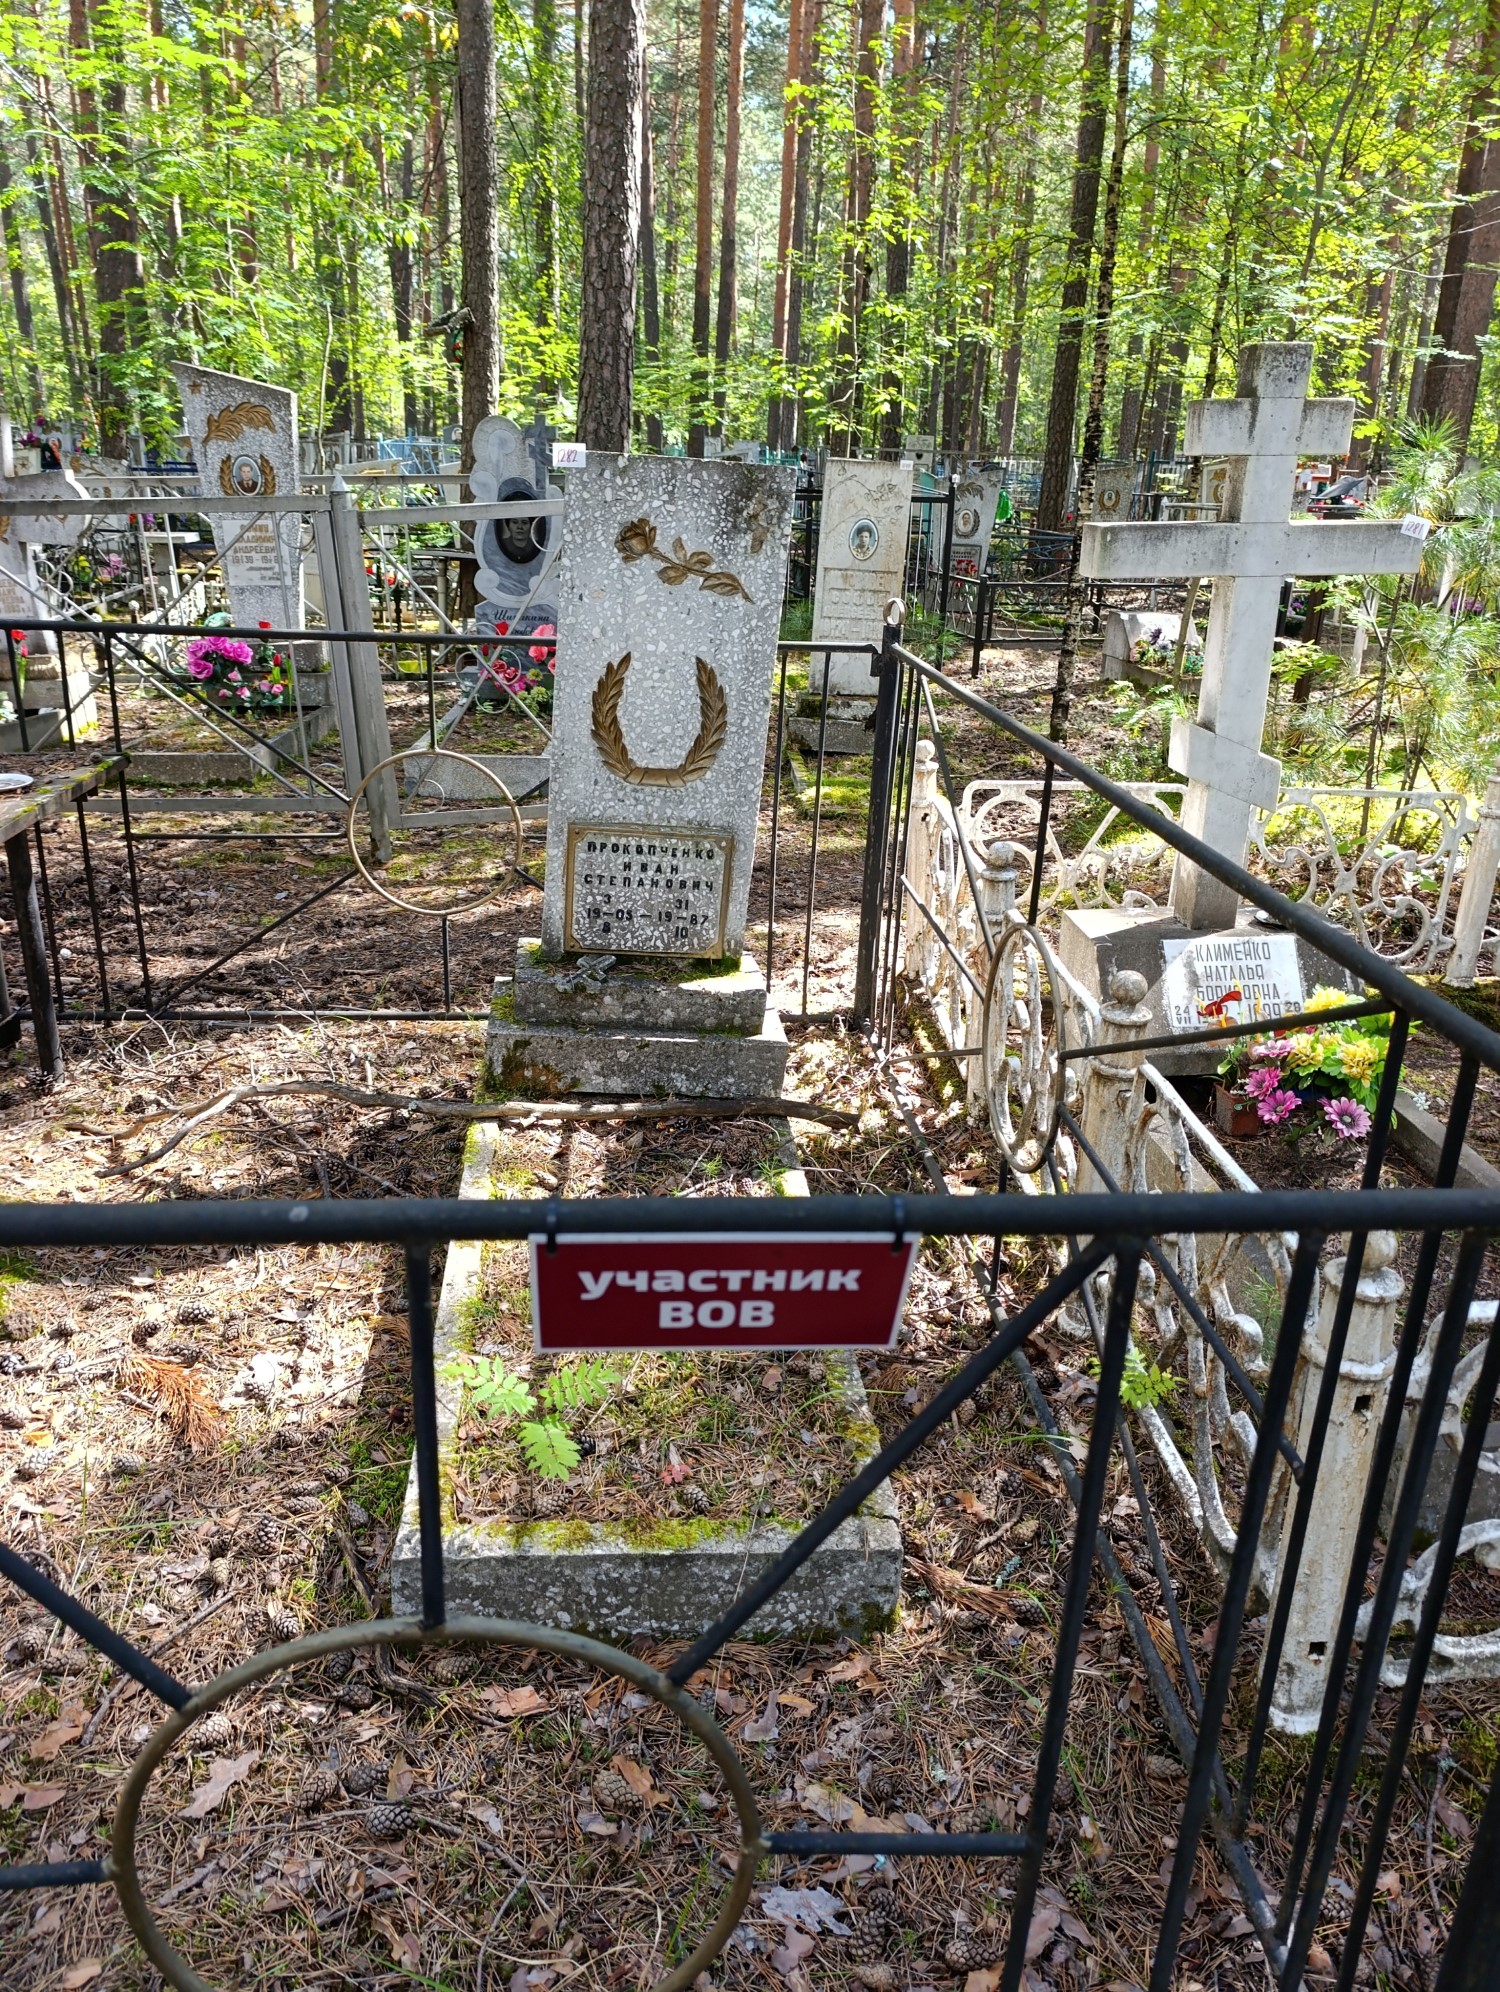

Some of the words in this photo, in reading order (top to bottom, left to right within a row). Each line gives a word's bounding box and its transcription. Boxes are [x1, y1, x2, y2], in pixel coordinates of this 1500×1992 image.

[233, 545, 276, 554] АНДРЕЕВИ
[587, 841, 714, 860] ПРОКОПЧЕНКО
[623, 862, 679, 875] ИВАН
[584, 874, 713, 891] СТЕПАНОВИЧ
[603, 894, 611, 904] 3
[675, 899, 689, 910] 31
[602, 922, 611, 933] 8
[675, 926, 689, 939] 10
[1195, 942, 1271, 962] КЛИМЕНКО
[1204, 964, 1265, 982] НАТАЛЬЯ
[1174, 1005, 1190, 1016] 24
[1176, 1017, 1191, 1025] VII
[577, 1268, 862, 1301] участник
[658, 1300, 776, 1330] ВОВ
